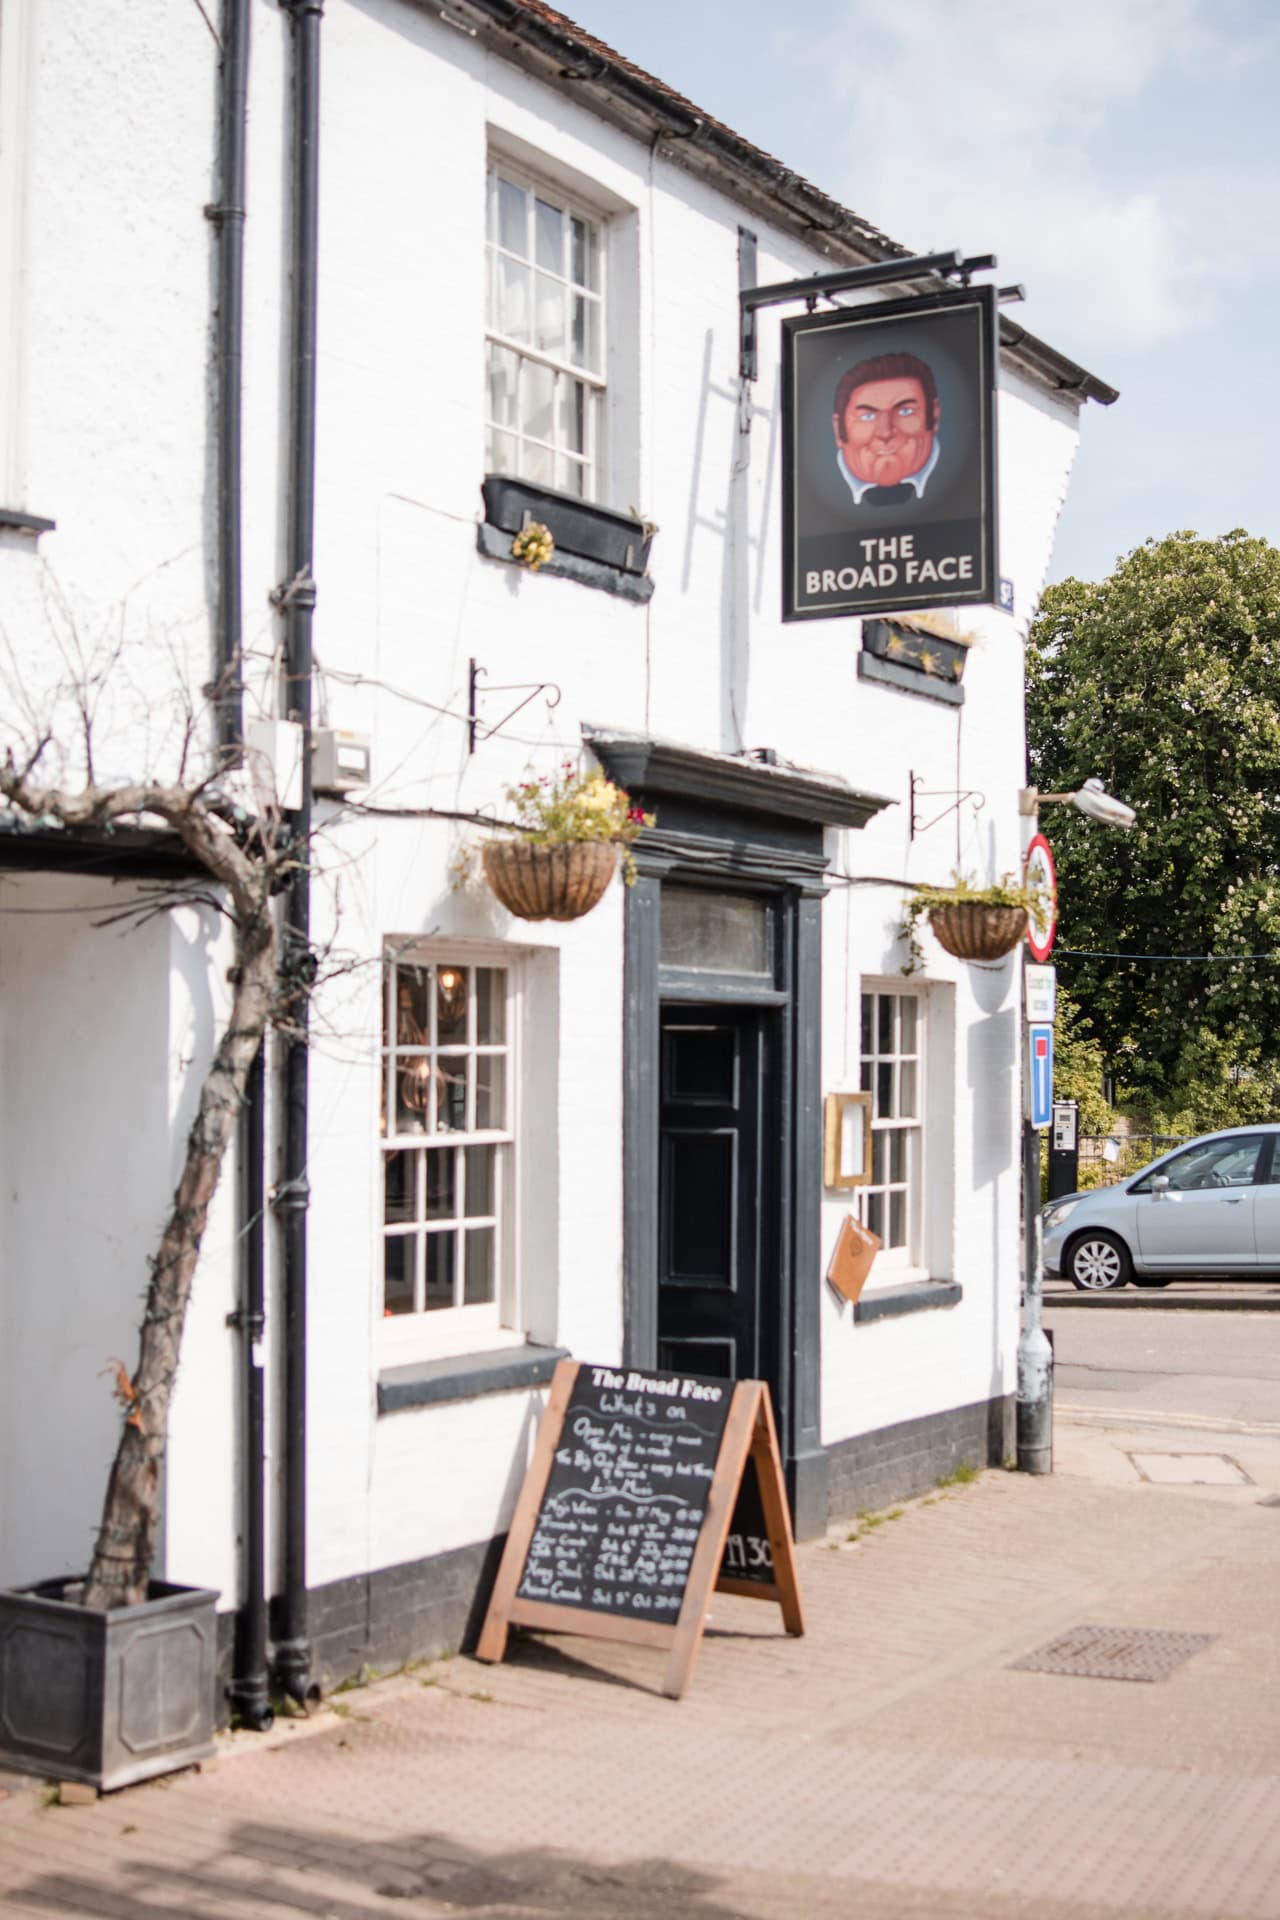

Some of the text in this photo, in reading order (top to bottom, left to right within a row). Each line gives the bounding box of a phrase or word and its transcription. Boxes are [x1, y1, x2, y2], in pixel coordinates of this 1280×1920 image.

[859, 535, 914, 562] THE
[806, 555, 973, 594] BROAD FACE
[592, 1368, 722, 1402] The Broad Face
